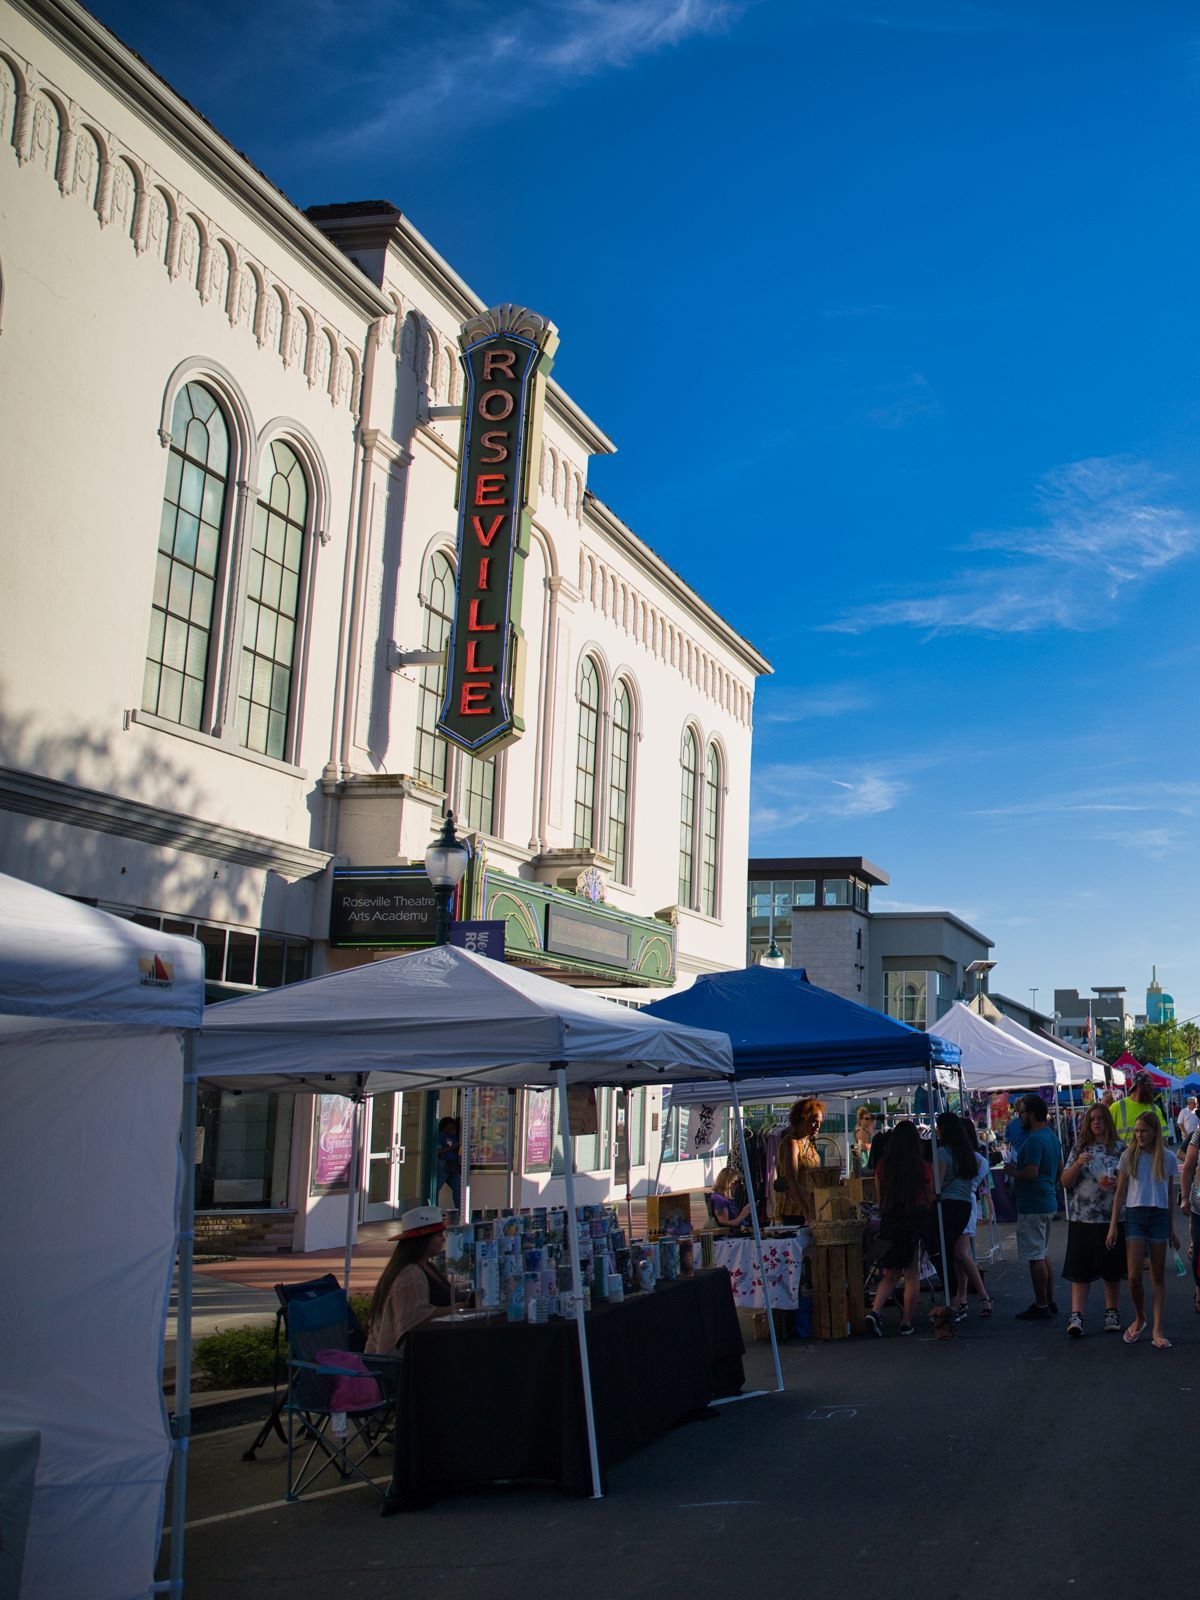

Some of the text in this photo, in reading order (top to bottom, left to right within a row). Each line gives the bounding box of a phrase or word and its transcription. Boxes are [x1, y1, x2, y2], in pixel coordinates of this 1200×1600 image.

[460, 349, 517, 716] ROSEVILLE
[342, 896, 436, 907] Roseville Theatre
[348, 911, 428, 923] Arts Academy
